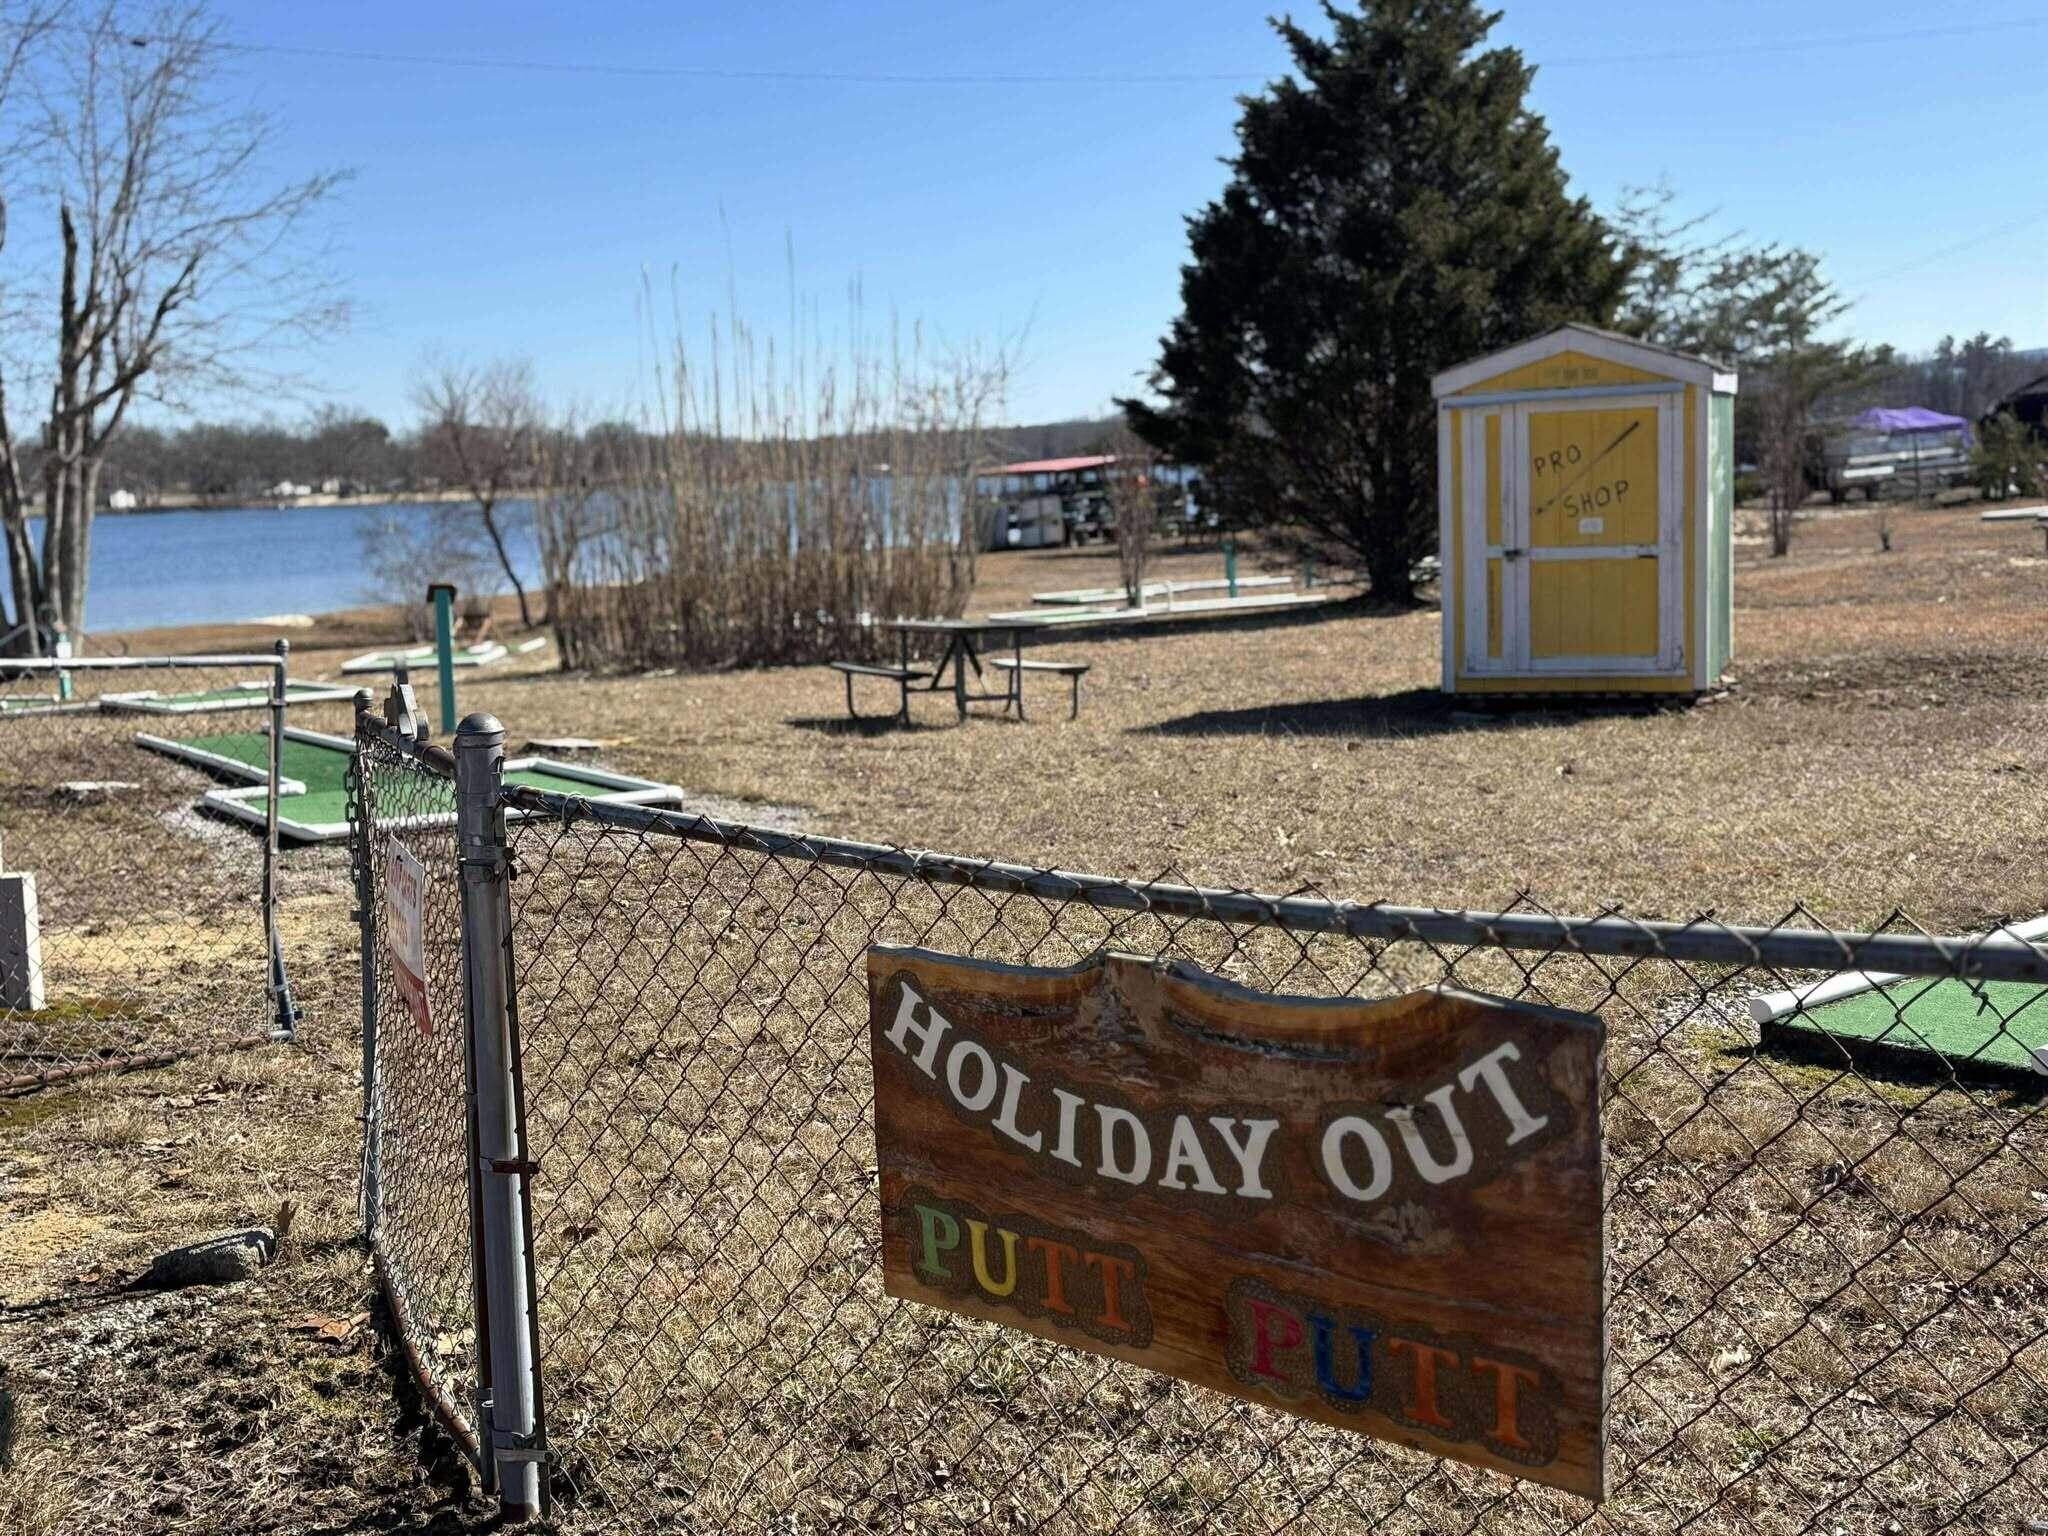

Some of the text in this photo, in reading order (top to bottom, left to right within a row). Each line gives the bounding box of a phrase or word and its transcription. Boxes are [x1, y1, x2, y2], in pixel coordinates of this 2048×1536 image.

[1534, 445, 1582, 477] PRO
[1563, 480, 1629, 518] SHOP
[883, 980, 1548, 1201] HOLIDAY OUT
[914, 1203, 1541, 1450] PUTT PUTT
